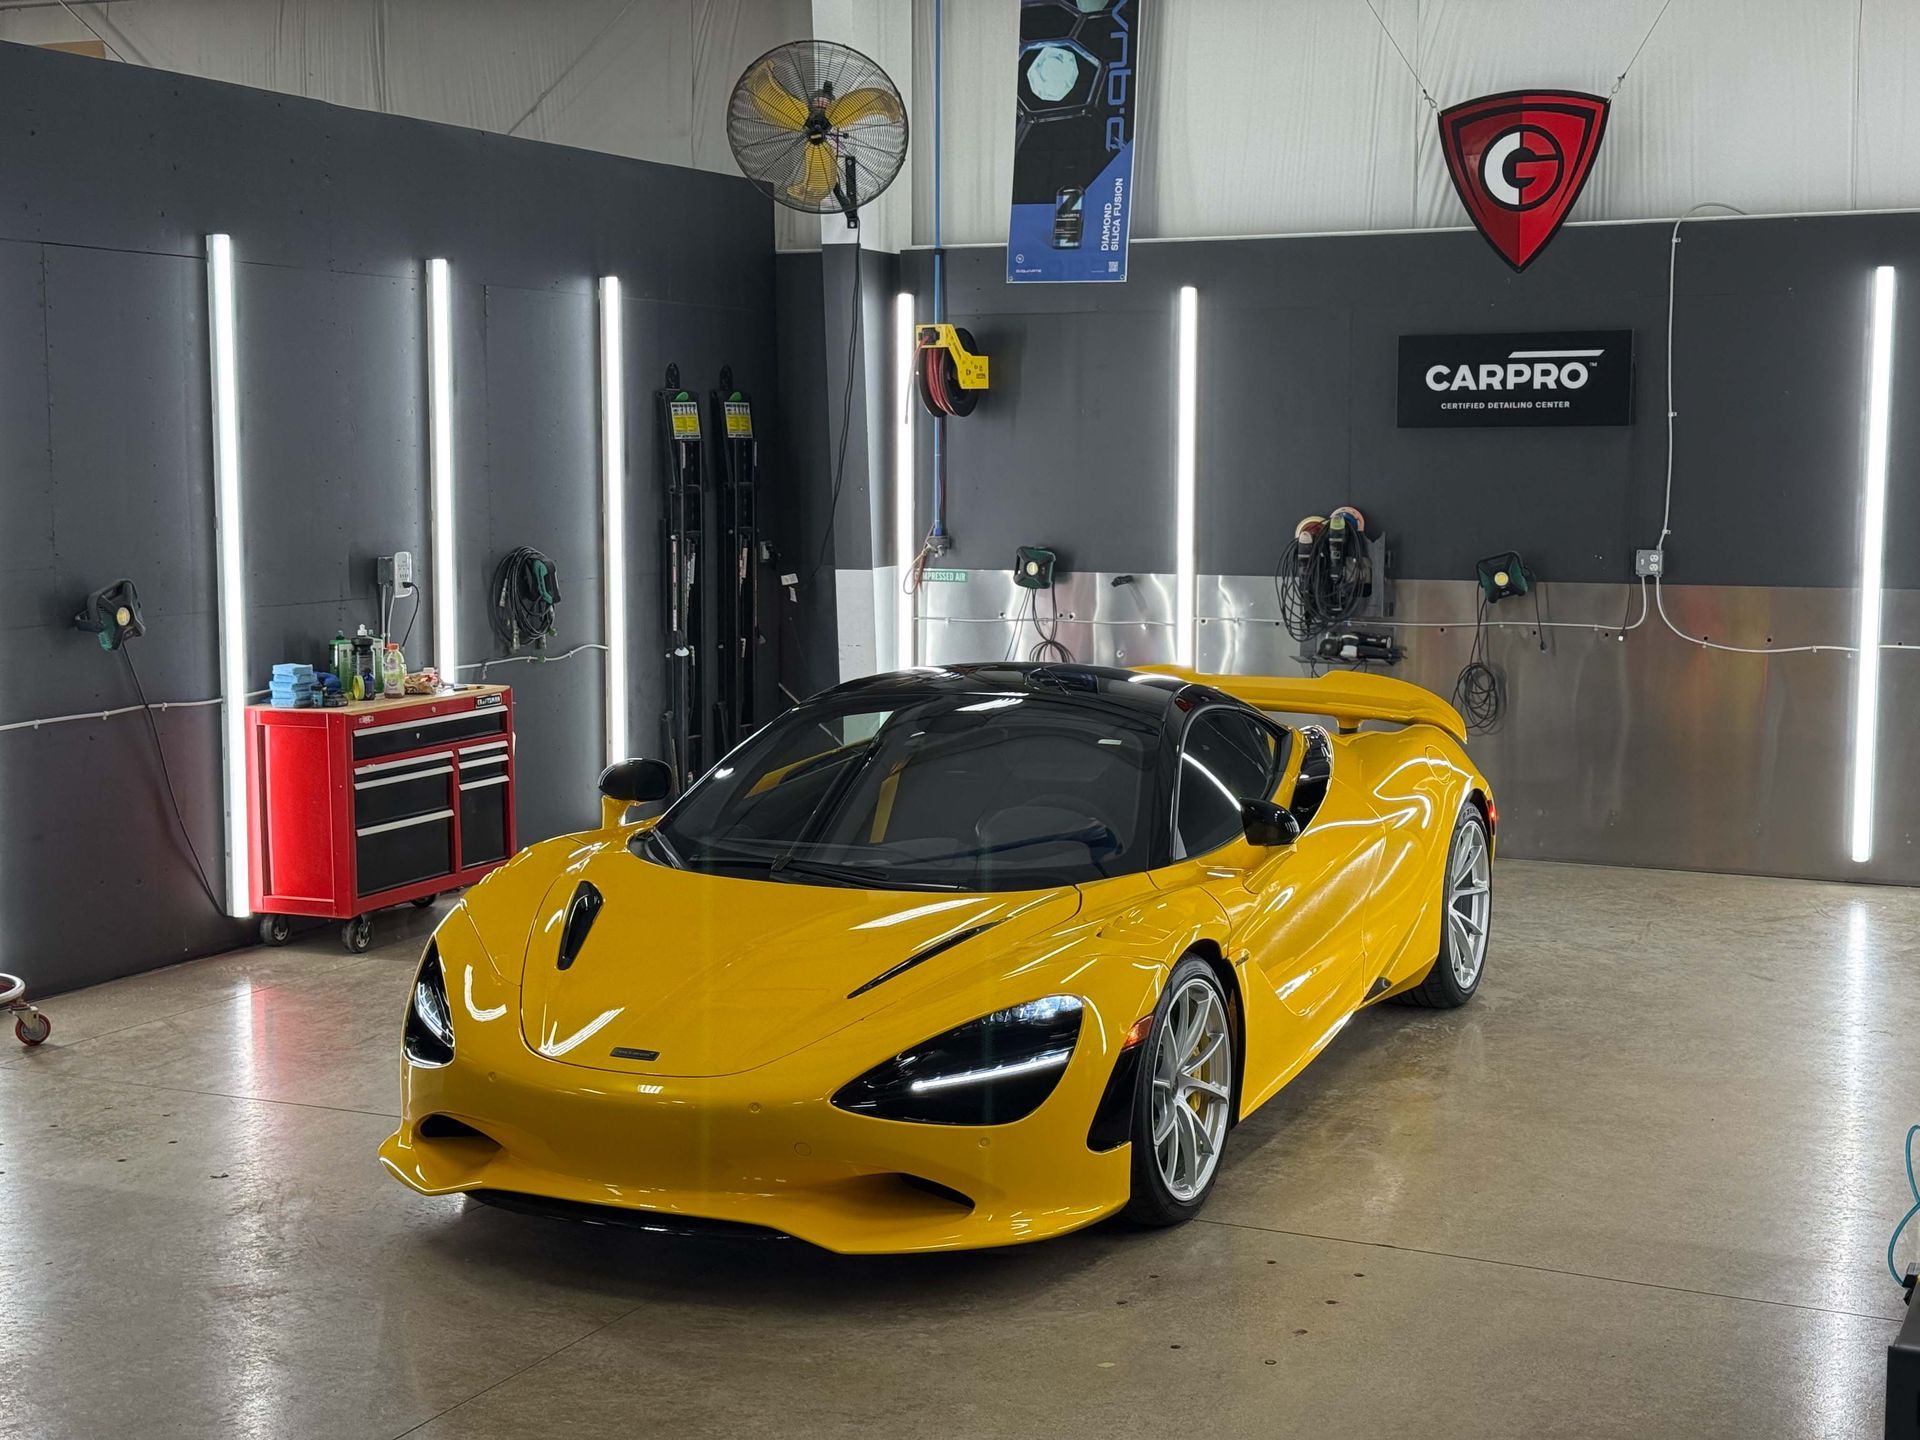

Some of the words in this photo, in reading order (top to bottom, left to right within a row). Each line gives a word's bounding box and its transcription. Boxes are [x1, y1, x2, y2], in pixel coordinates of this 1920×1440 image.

[1114, 177, 1124, 216] FUSION
[1101, 202, 1112, 251] DIAMOND
[1112, 218, 1121, 251] SILICA
[1425, 361, 1589, 392] CARPRO
[1440, 402, 1485, 410] CERTIFIED
[1488, 401, 1533, 409] DETAILING
[1535, 400, 1570, 408] CENTER
[914, 571, 954, 581] CMPRESSED
[955, 572, 966, 581] AIR
